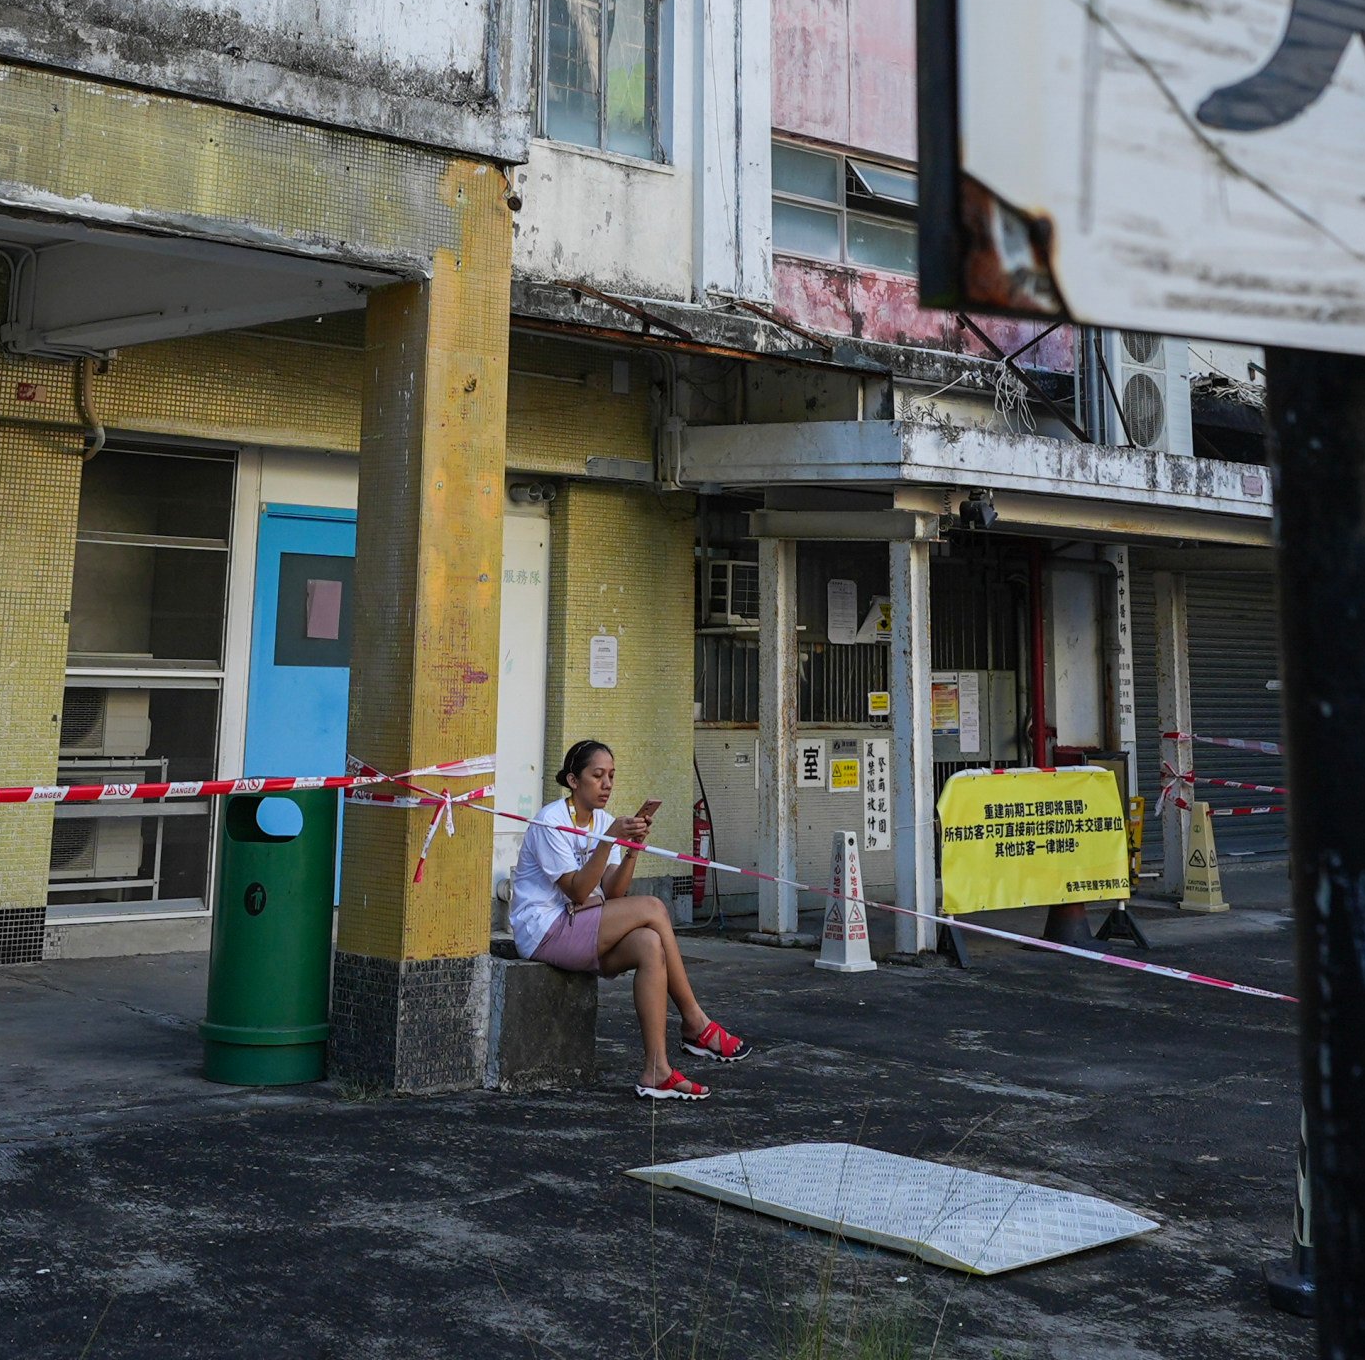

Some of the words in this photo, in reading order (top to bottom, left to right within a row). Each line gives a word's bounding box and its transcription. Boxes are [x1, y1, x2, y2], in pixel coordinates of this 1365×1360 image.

[803, 746, 819, 780] 室
[33, 791, 62, 800] DANGER
[170, 787, 197, 795] DANGER
[944, 816, 1123, 843] 所有訪客只可直接前往探訪仍未交還單位
[995, 837, 1079, 858] 其他訪客一律謝絕。
[849, 851, 858, 898] 小心地滑
[849, 924, 864, 932] CAUTION
